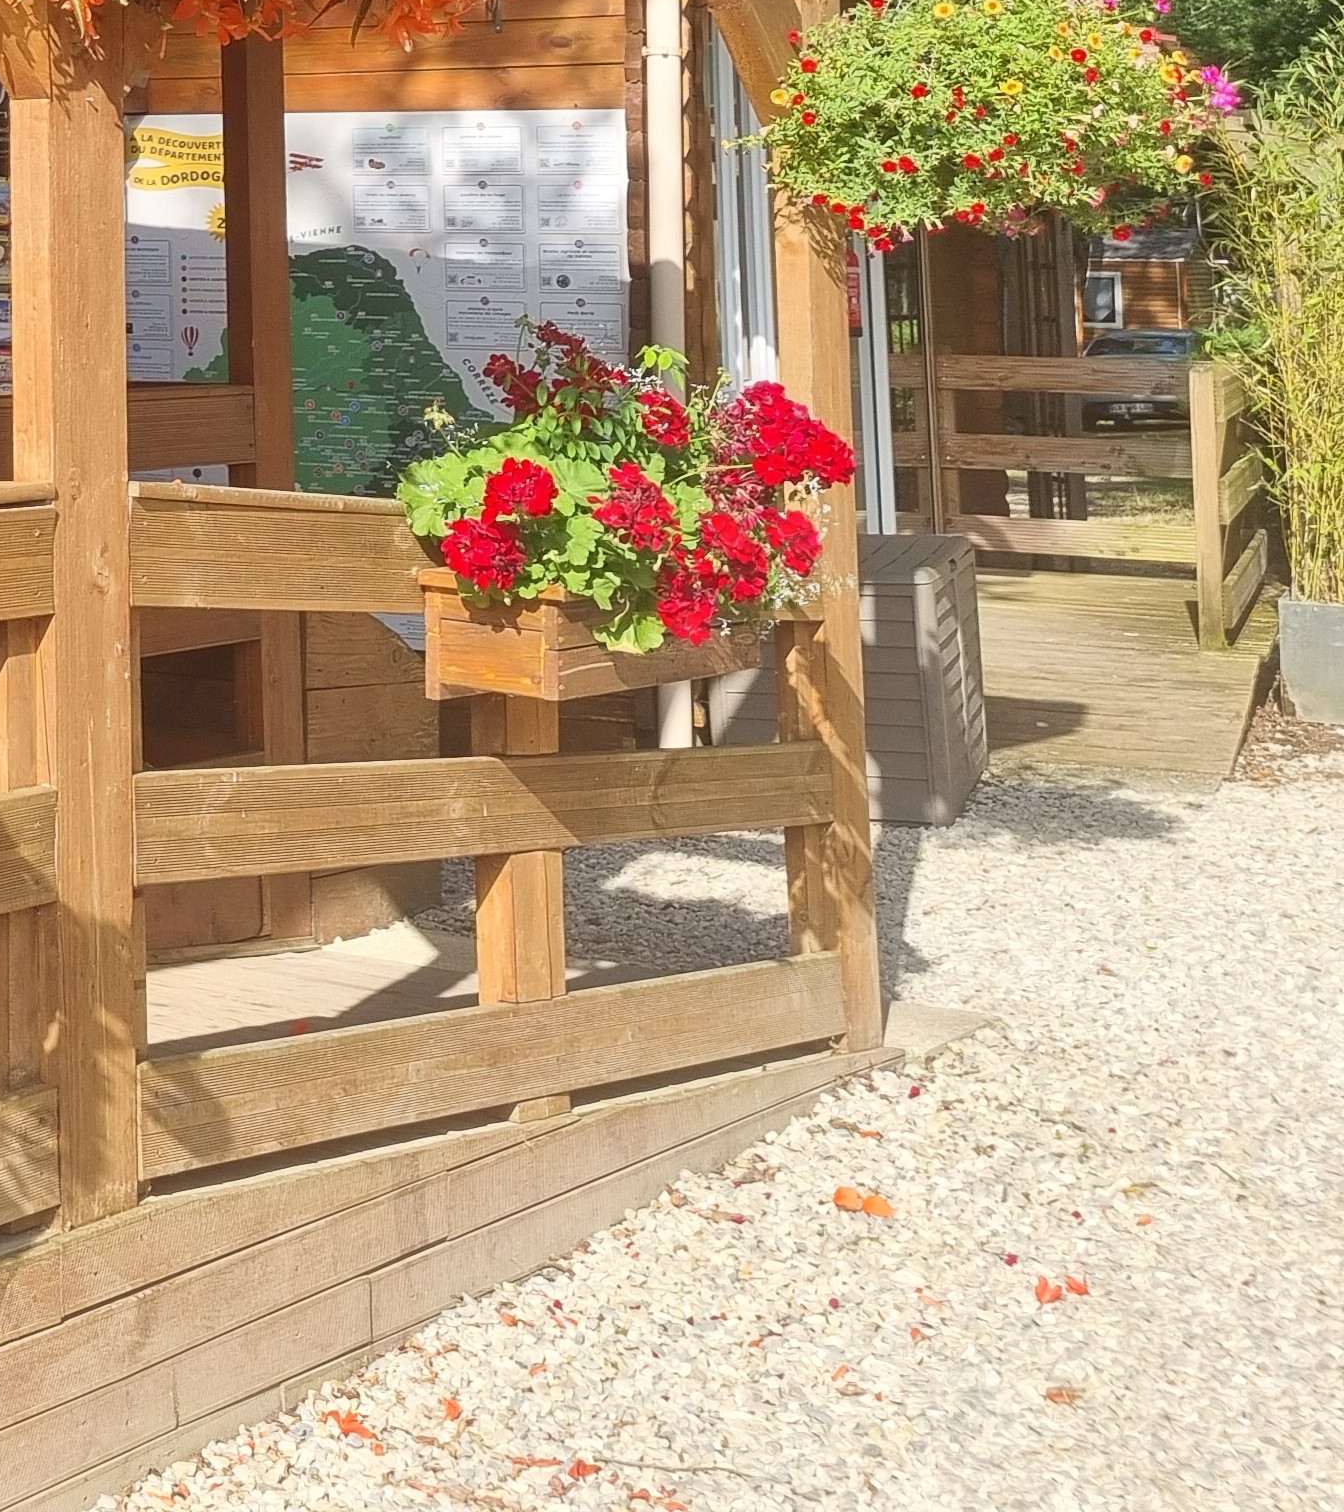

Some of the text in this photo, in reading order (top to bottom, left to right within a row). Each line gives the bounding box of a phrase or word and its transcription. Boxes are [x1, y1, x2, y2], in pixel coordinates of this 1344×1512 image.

[141, 133, 154, 143] LA
[158, 135, 222, 151] DÉCOUVERT
[130, 144, 223, 162] DU DÉPARTEMEN
[133, 176, 145, 185] DE
[160, 170, 223, 186] DORDOG
[289, 225, 342, 244] E-VIENNE
